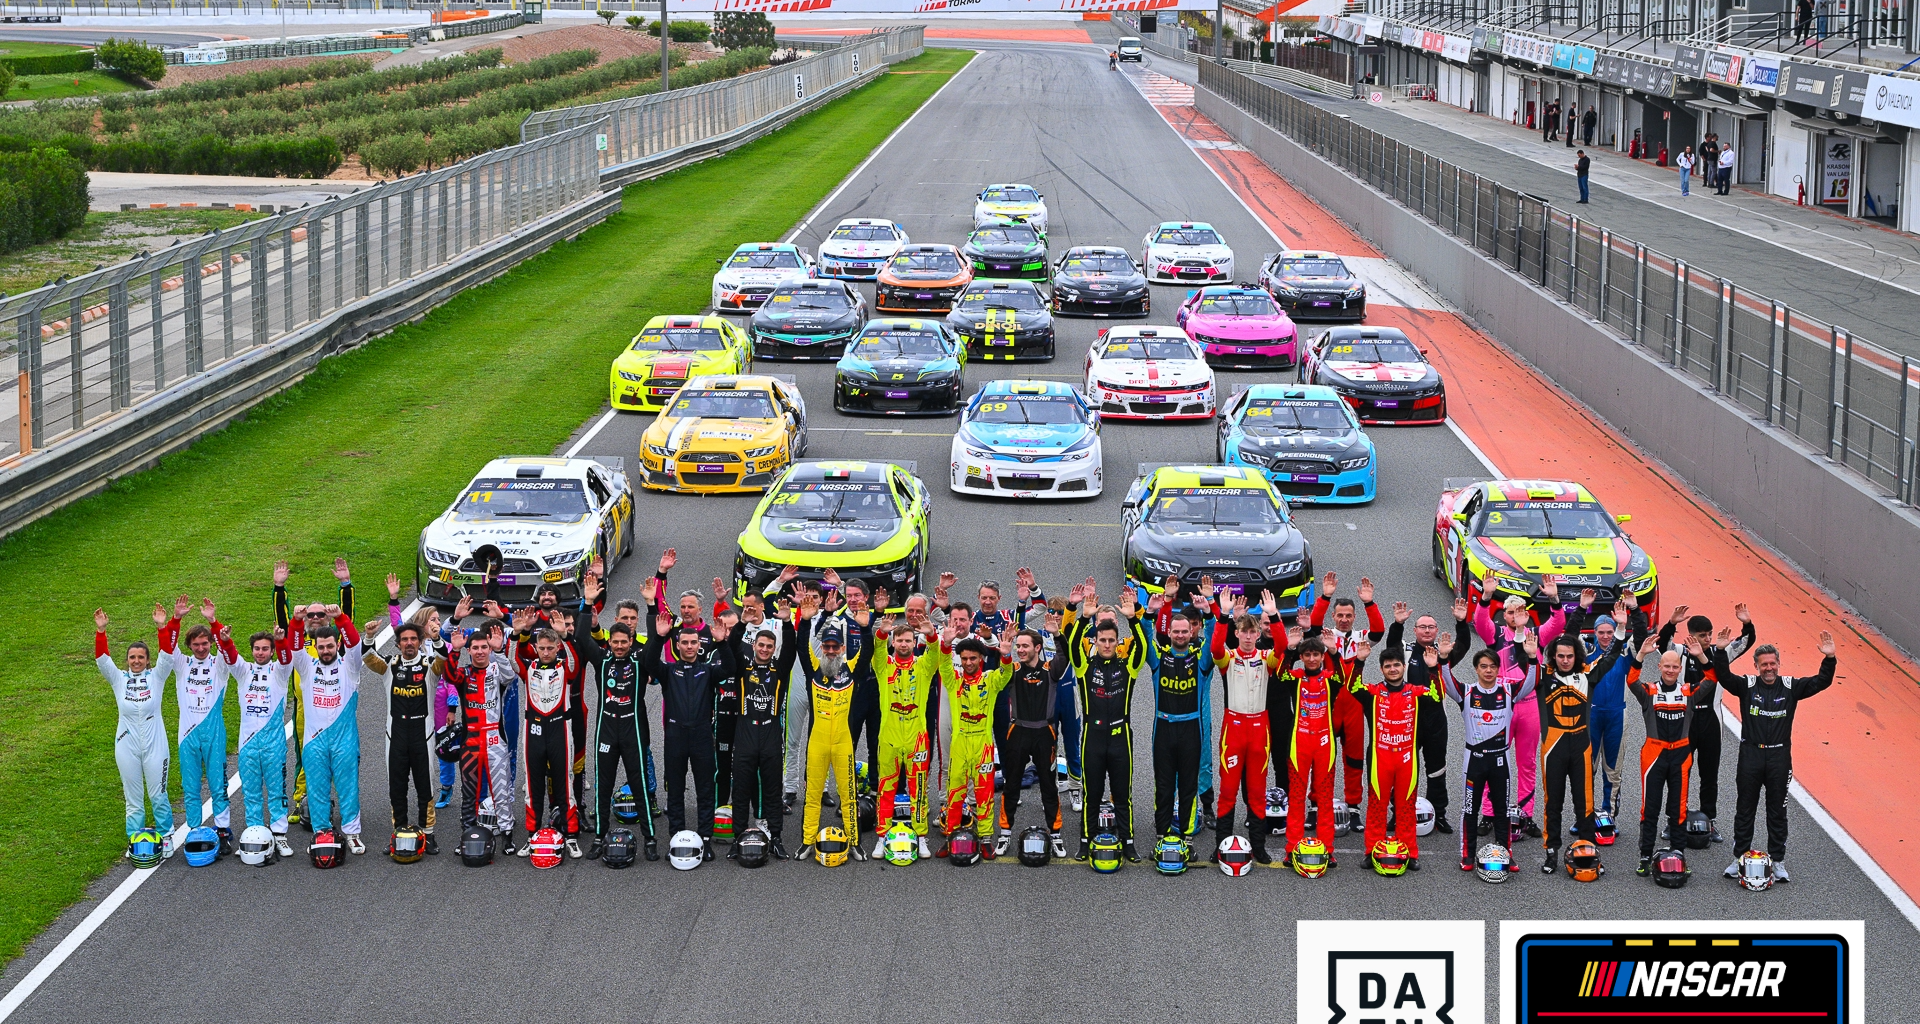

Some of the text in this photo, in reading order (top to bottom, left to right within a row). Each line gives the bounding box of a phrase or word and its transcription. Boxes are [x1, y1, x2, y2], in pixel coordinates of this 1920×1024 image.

[1888, 92, 1913, 111] VALENCIA
[1830, 179, 1849, 198] 13
[974, 322, 1024, 331] DINOIL
[639, 335, 661, 343] 30
[860, 337, 880, 345] 34
[1107, 344, 1129, 352] 99
[1332, 345, 1353, 353] 48
[1103, 392, 1113, 400] 99
[677, 399, 690, 409] 5
[979, 402, 1008, 412] 69
[1246, 407, 1273, 417] 64
[1275, 452, 1333, 460] SPEEDHOUSE
[744, 460, 756, 475] 5
[966, 465, 981, 476] 69
[468, 491, 493, 502] 11
[773, 493, 801, 504] 24
[1161, 498, 1176, 509] 7
[1489, 511, 1503, 524] 3
[1173, 528, 1265, 539] orion
[1207, 558, 1239, 566] orion
[545, 572, 561, 580] HPM
[1153, 576, 1162, 584] 7
[1160, 676, 1197, 690] orion
[393, 686, 424, 698] DINOIL
[530, 724, 542, 736] 99
[1111, 727, 1122, 736] 24
[489, 736, 499, 746] 99
[912, 750, 928, 762] 30
[1227, 755, 1238, 768] 3
[978, 762, 994, 774] 30
